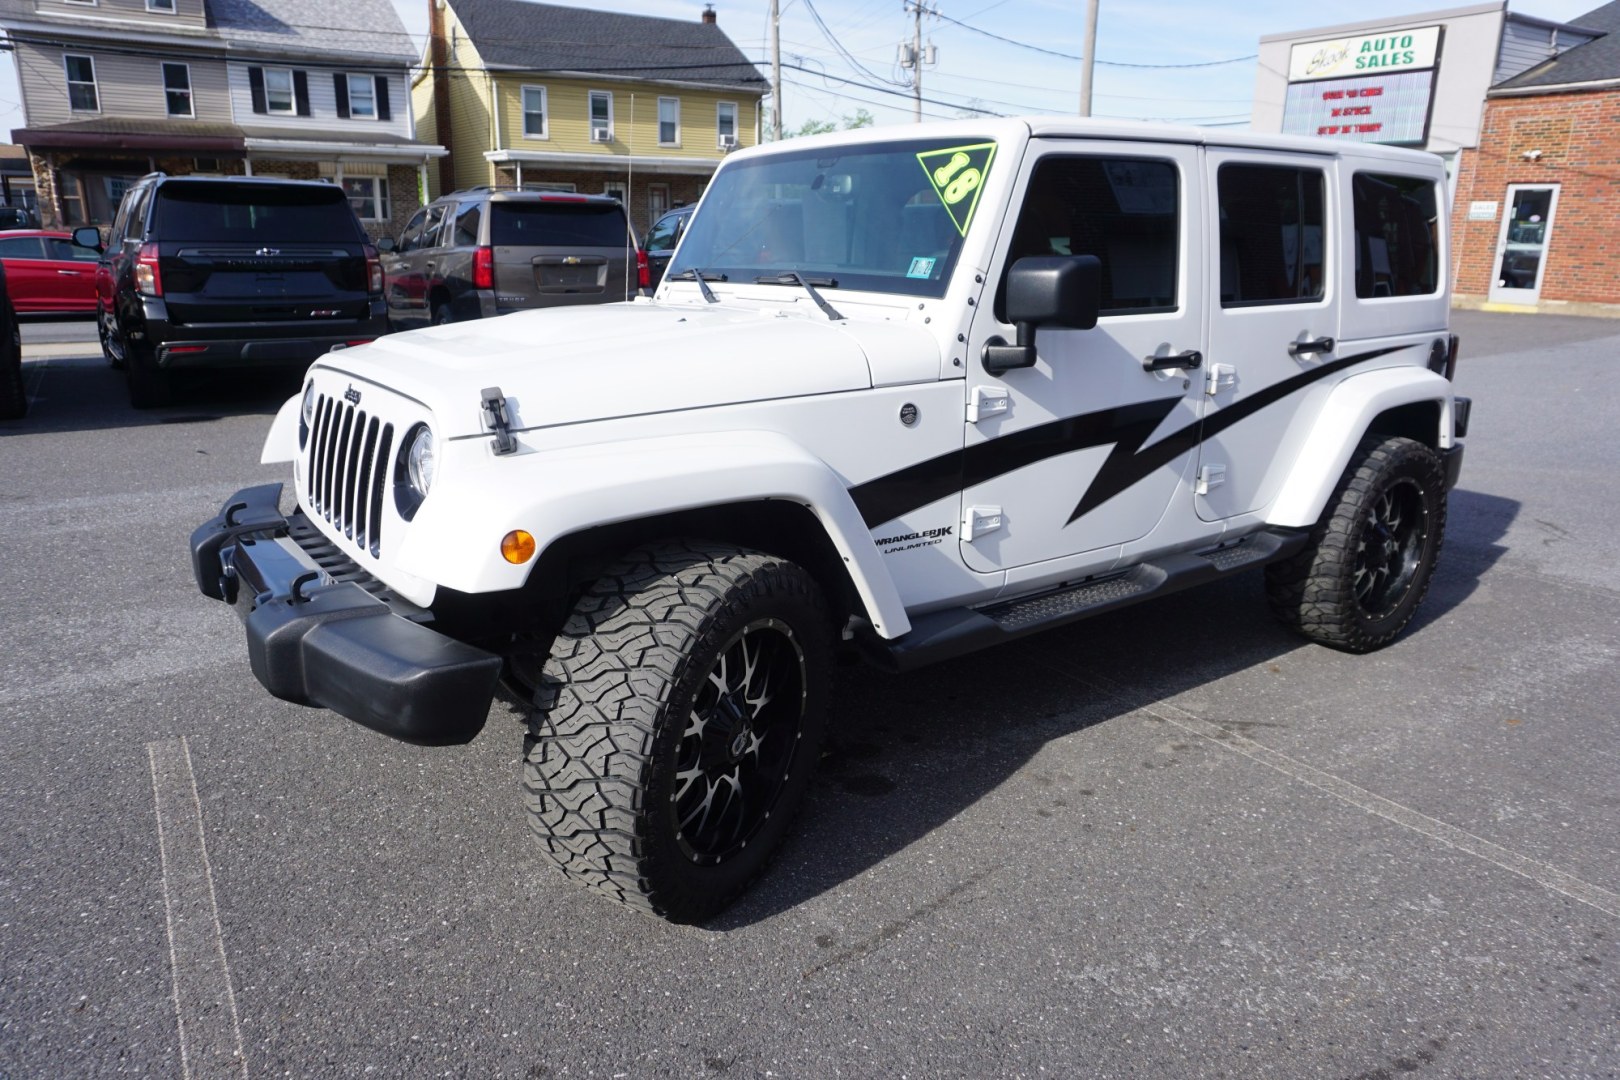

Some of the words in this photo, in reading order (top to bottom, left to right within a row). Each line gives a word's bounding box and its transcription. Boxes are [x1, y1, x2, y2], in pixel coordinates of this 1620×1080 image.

[1360, 35, 1413, 53] AUTO
[1355, 50, 1414, 69] SALES
[934, 152, 981, 204] 18
[884, 538, 943, 554] UNLIMITED
